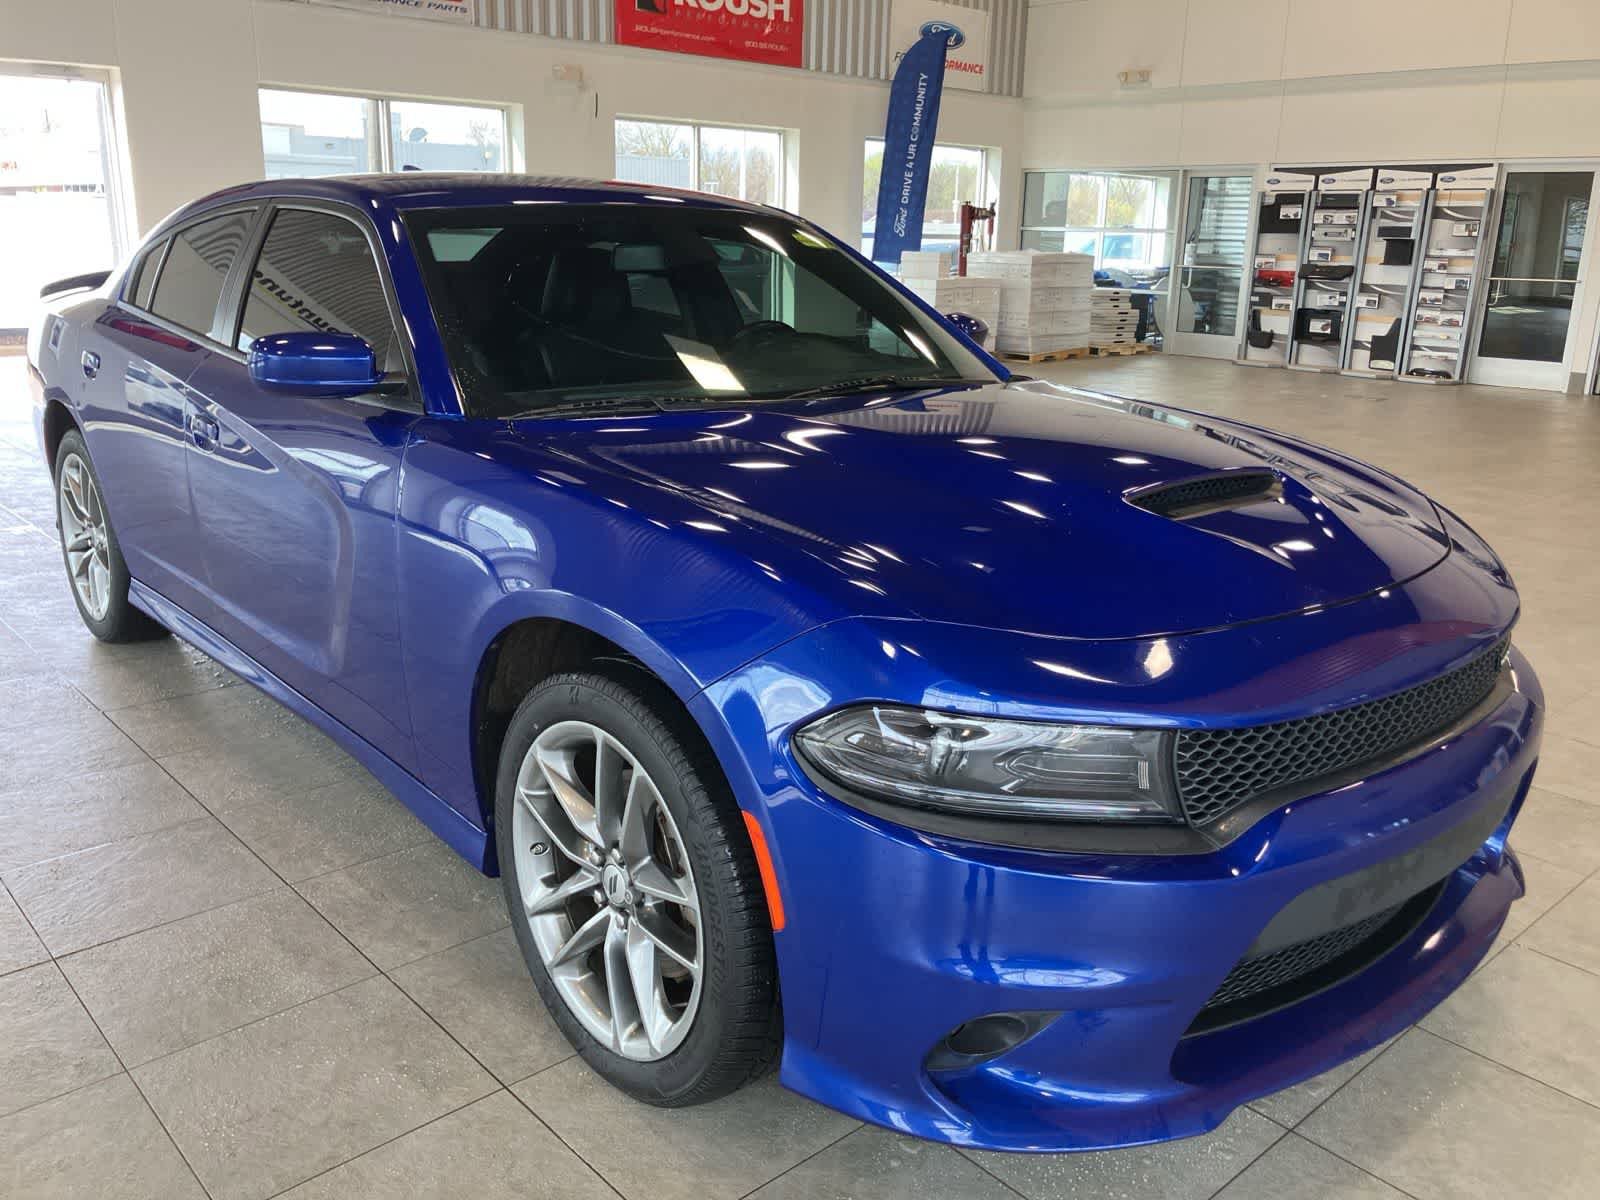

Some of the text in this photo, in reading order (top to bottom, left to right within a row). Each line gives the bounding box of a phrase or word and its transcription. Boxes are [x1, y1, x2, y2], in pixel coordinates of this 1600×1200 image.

[427, 2, 468, 14] PARTS
[674, 0, 792, 22] USH
[893, 72, 929, 238] Ford DRIVE 4 UR COMMUNITY
